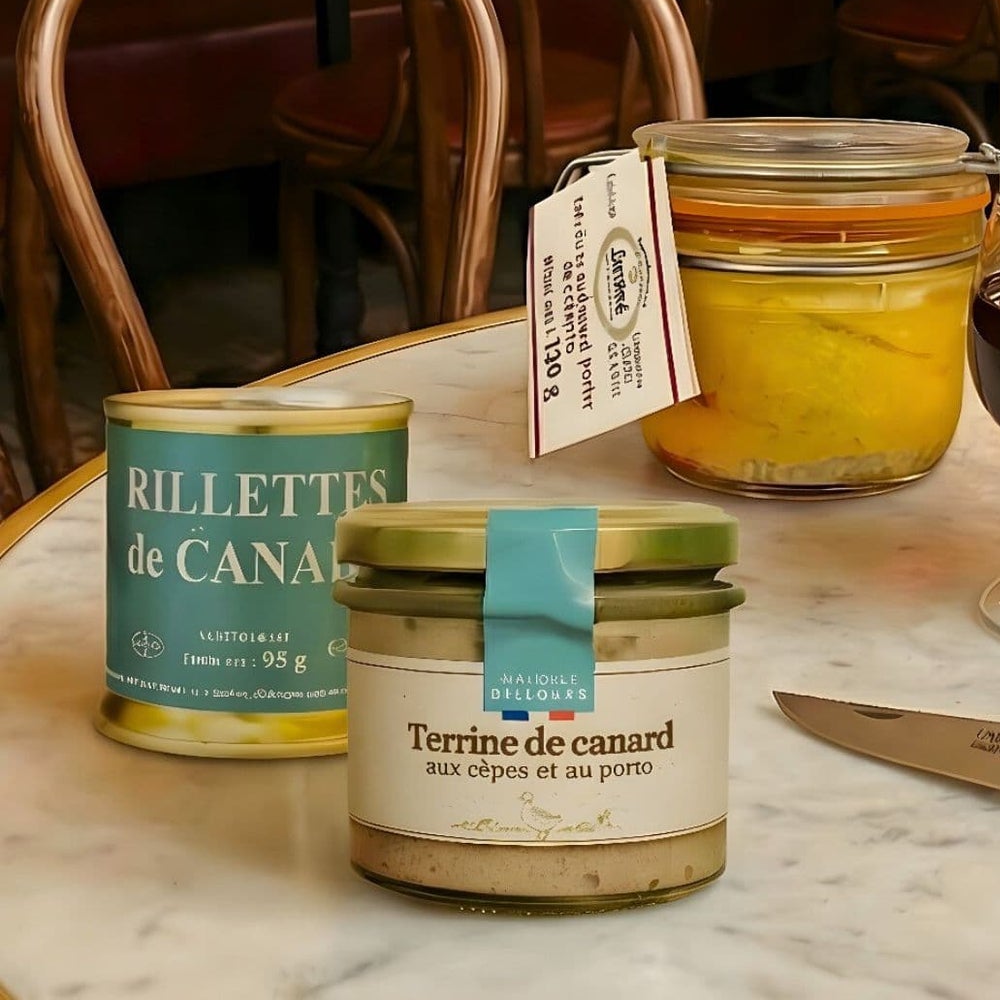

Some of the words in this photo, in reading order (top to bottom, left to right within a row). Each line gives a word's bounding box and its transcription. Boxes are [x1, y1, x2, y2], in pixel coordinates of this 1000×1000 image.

[127, 466, 388, 518] RILLETTES
[128, 532, 164, 578] de
[262, 650, 288, 669] 95
[294, 654, 307, 674] g
[407, 722, 519, 757] Terrine
[525, 725, 566, 757] de
[571, 720, 675, 757] canard
[425, 761, 461, 777] aux
[467, 759, 529, 784] cèpes
[536, 762, 558, 779] et
[565, 765, 593, 779] au
[599, 761, 653, 784] porto
